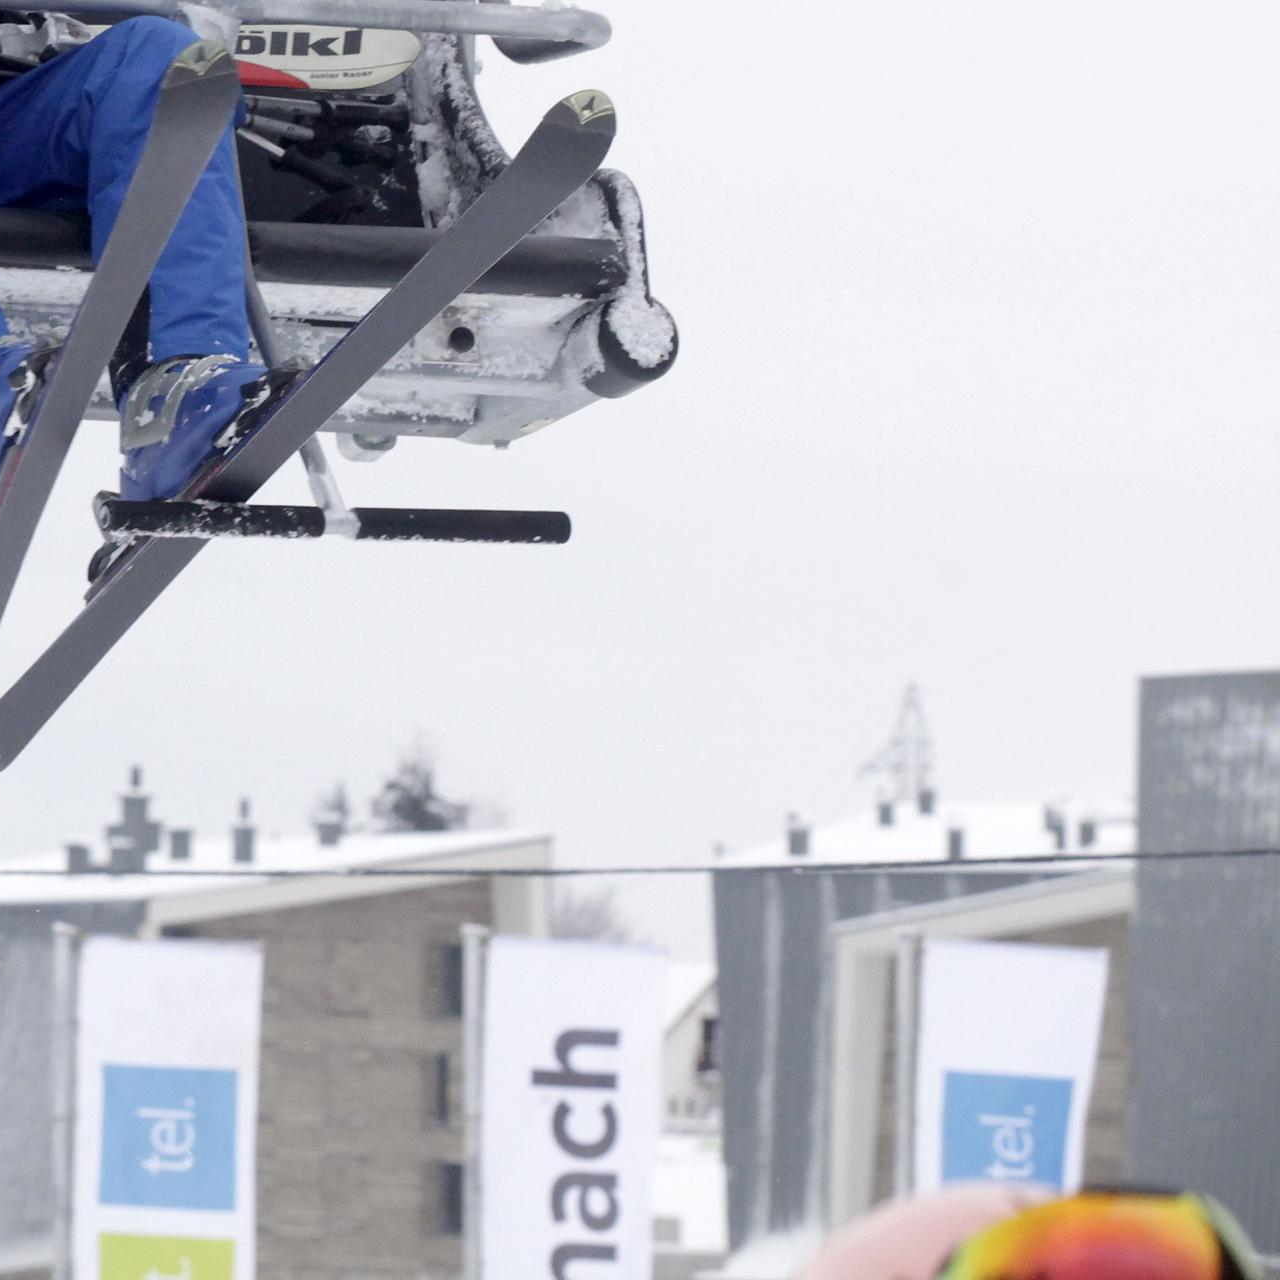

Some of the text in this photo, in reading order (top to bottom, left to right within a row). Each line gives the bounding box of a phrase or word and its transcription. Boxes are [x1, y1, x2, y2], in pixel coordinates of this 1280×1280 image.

[234, 29, 363, 56] ölkl
[309, 70, 374, 80] Junior Racer
[136, 1097, 196, 1175] tel.
[977, 1104, 1036, 1179] tel.
